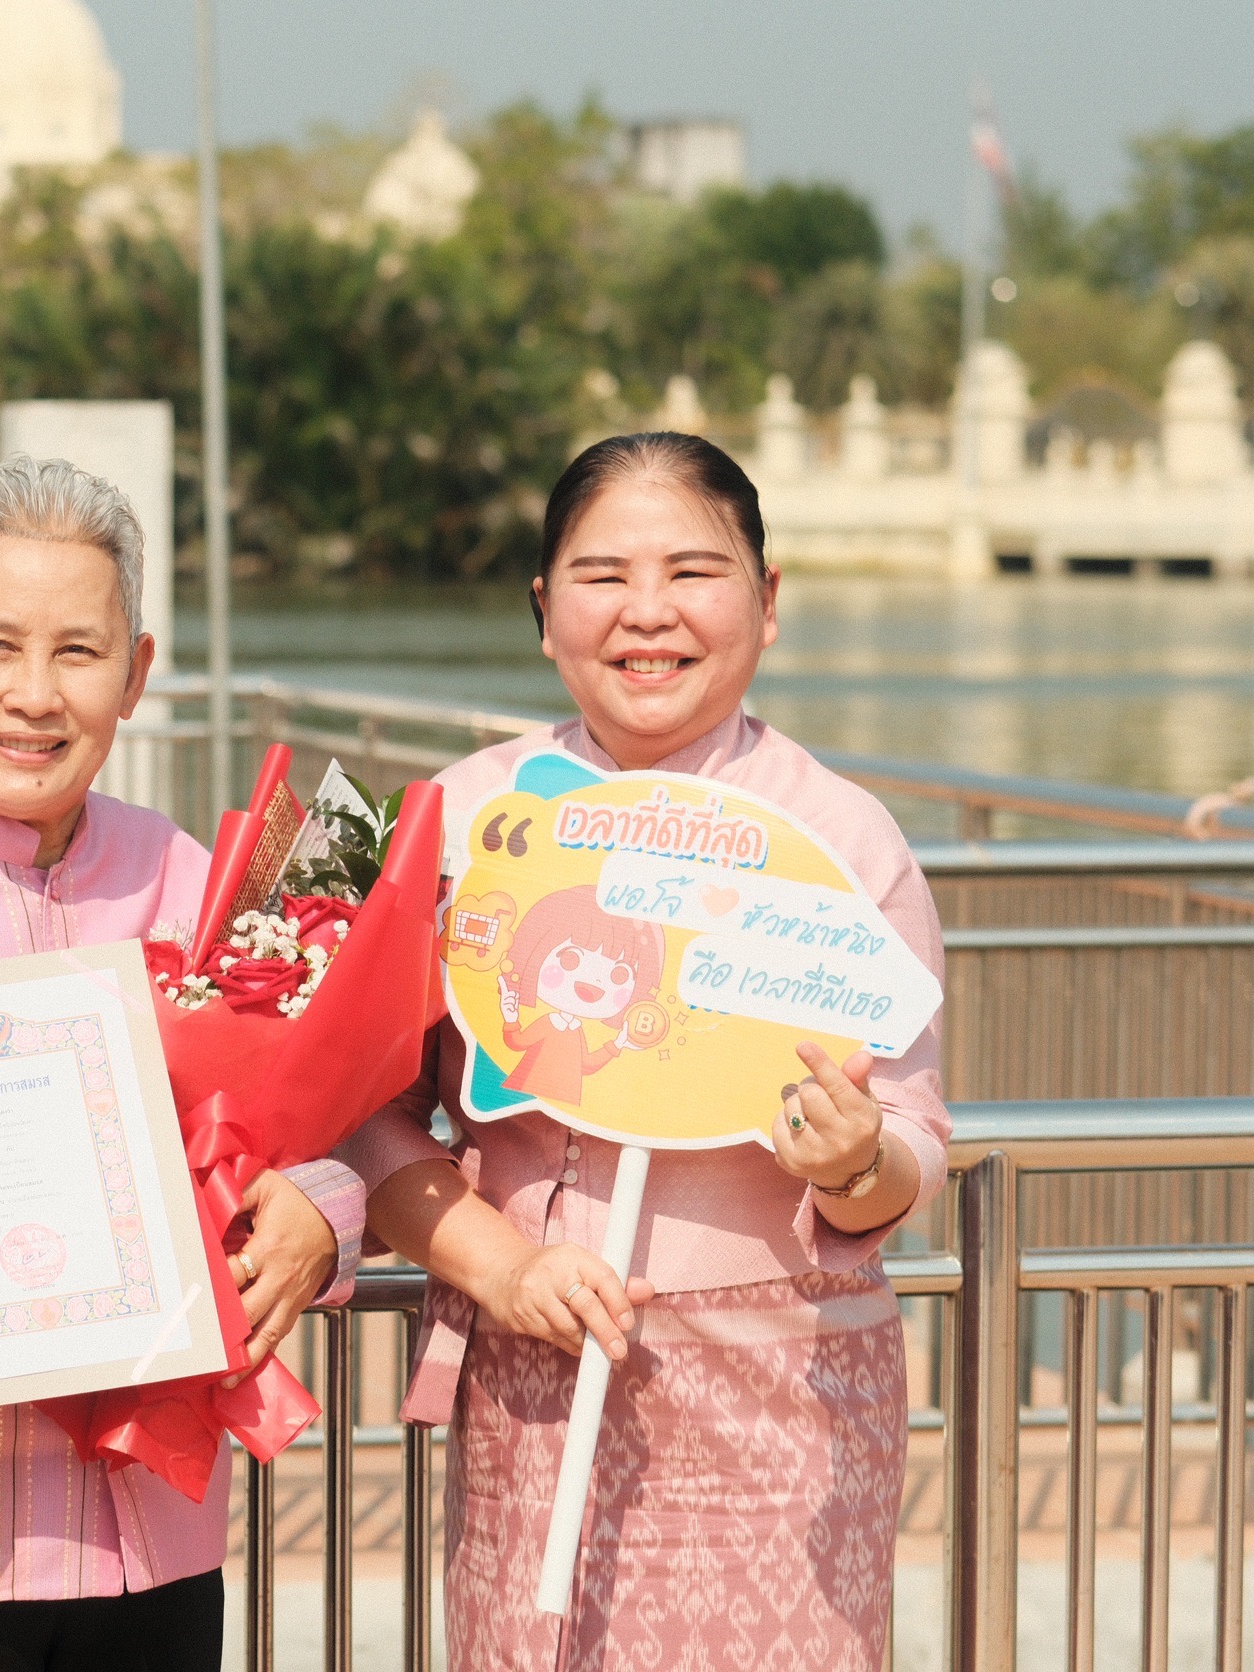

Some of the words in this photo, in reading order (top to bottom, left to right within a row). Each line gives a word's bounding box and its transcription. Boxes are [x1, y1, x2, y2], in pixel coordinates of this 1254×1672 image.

[558, 790, 763, 868] เวลาที่ดีที่สุด
[689, 950, 733, 988] คือ
[738, 962, 893, 1021] เวลาที่มีเธอ
